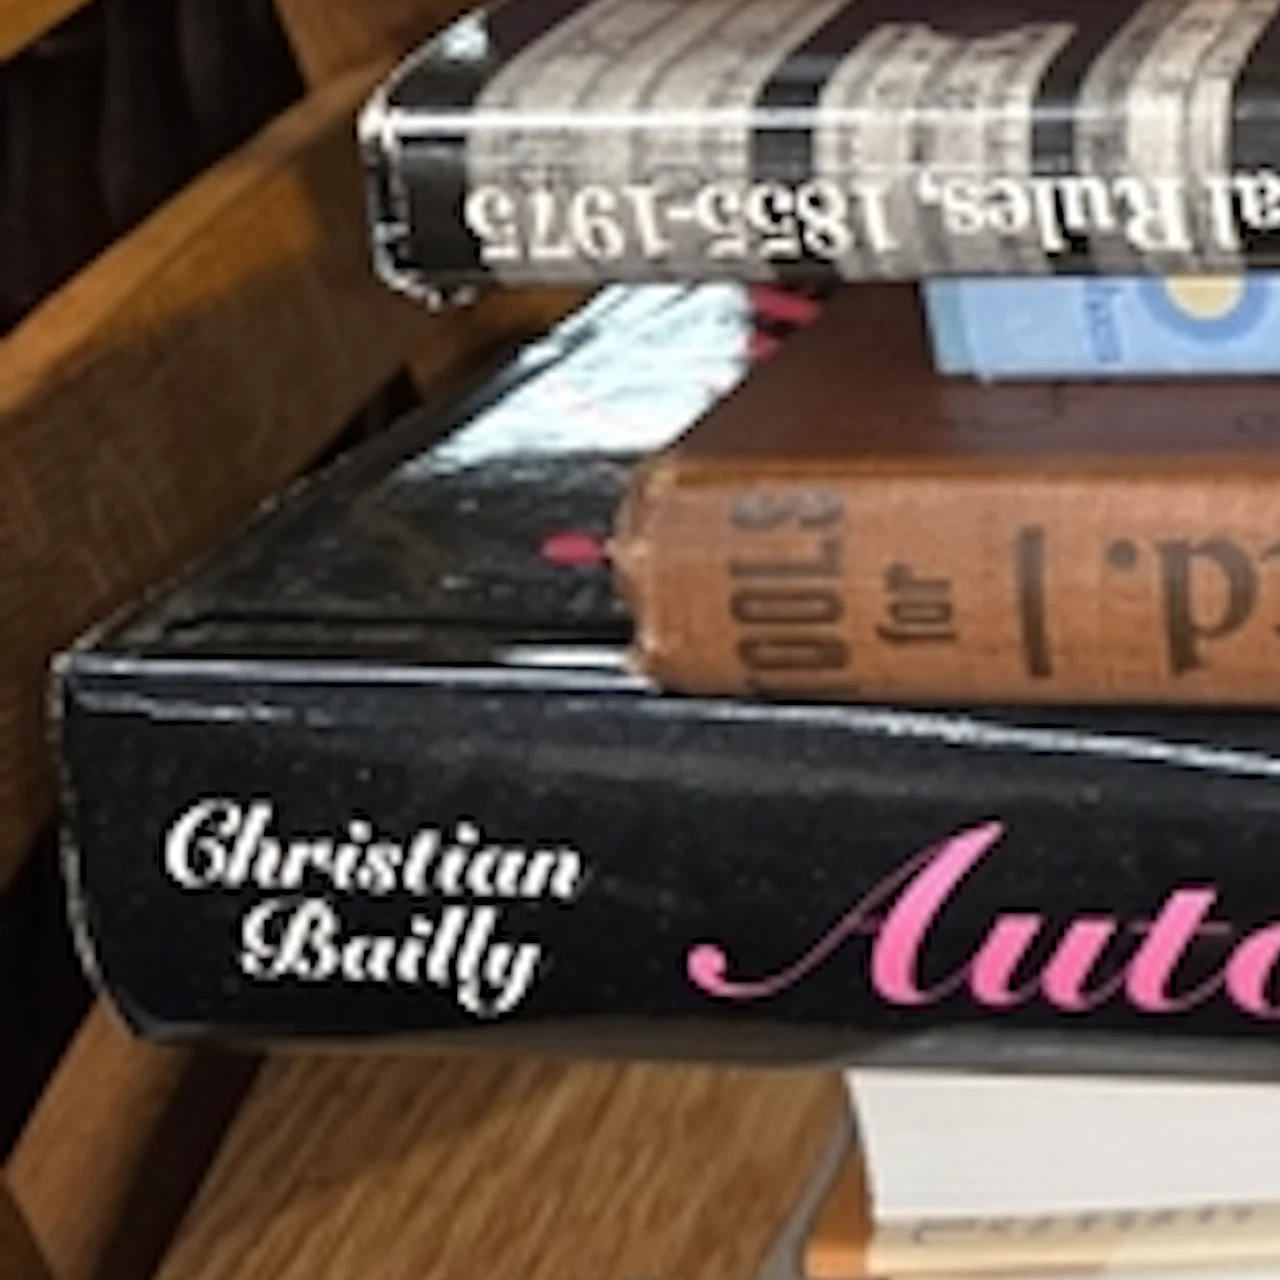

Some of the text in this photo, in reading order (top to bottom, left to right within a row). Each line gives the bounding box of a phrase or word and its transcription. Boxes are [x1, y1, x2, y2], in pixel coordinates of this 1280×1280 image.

[464, 178, 899, 263] 1855-1975
[915, 167, 1194, 251] Rules,
[163, 795, 586, 900] Christian
[238, 899, 547, 1020] Bailly
